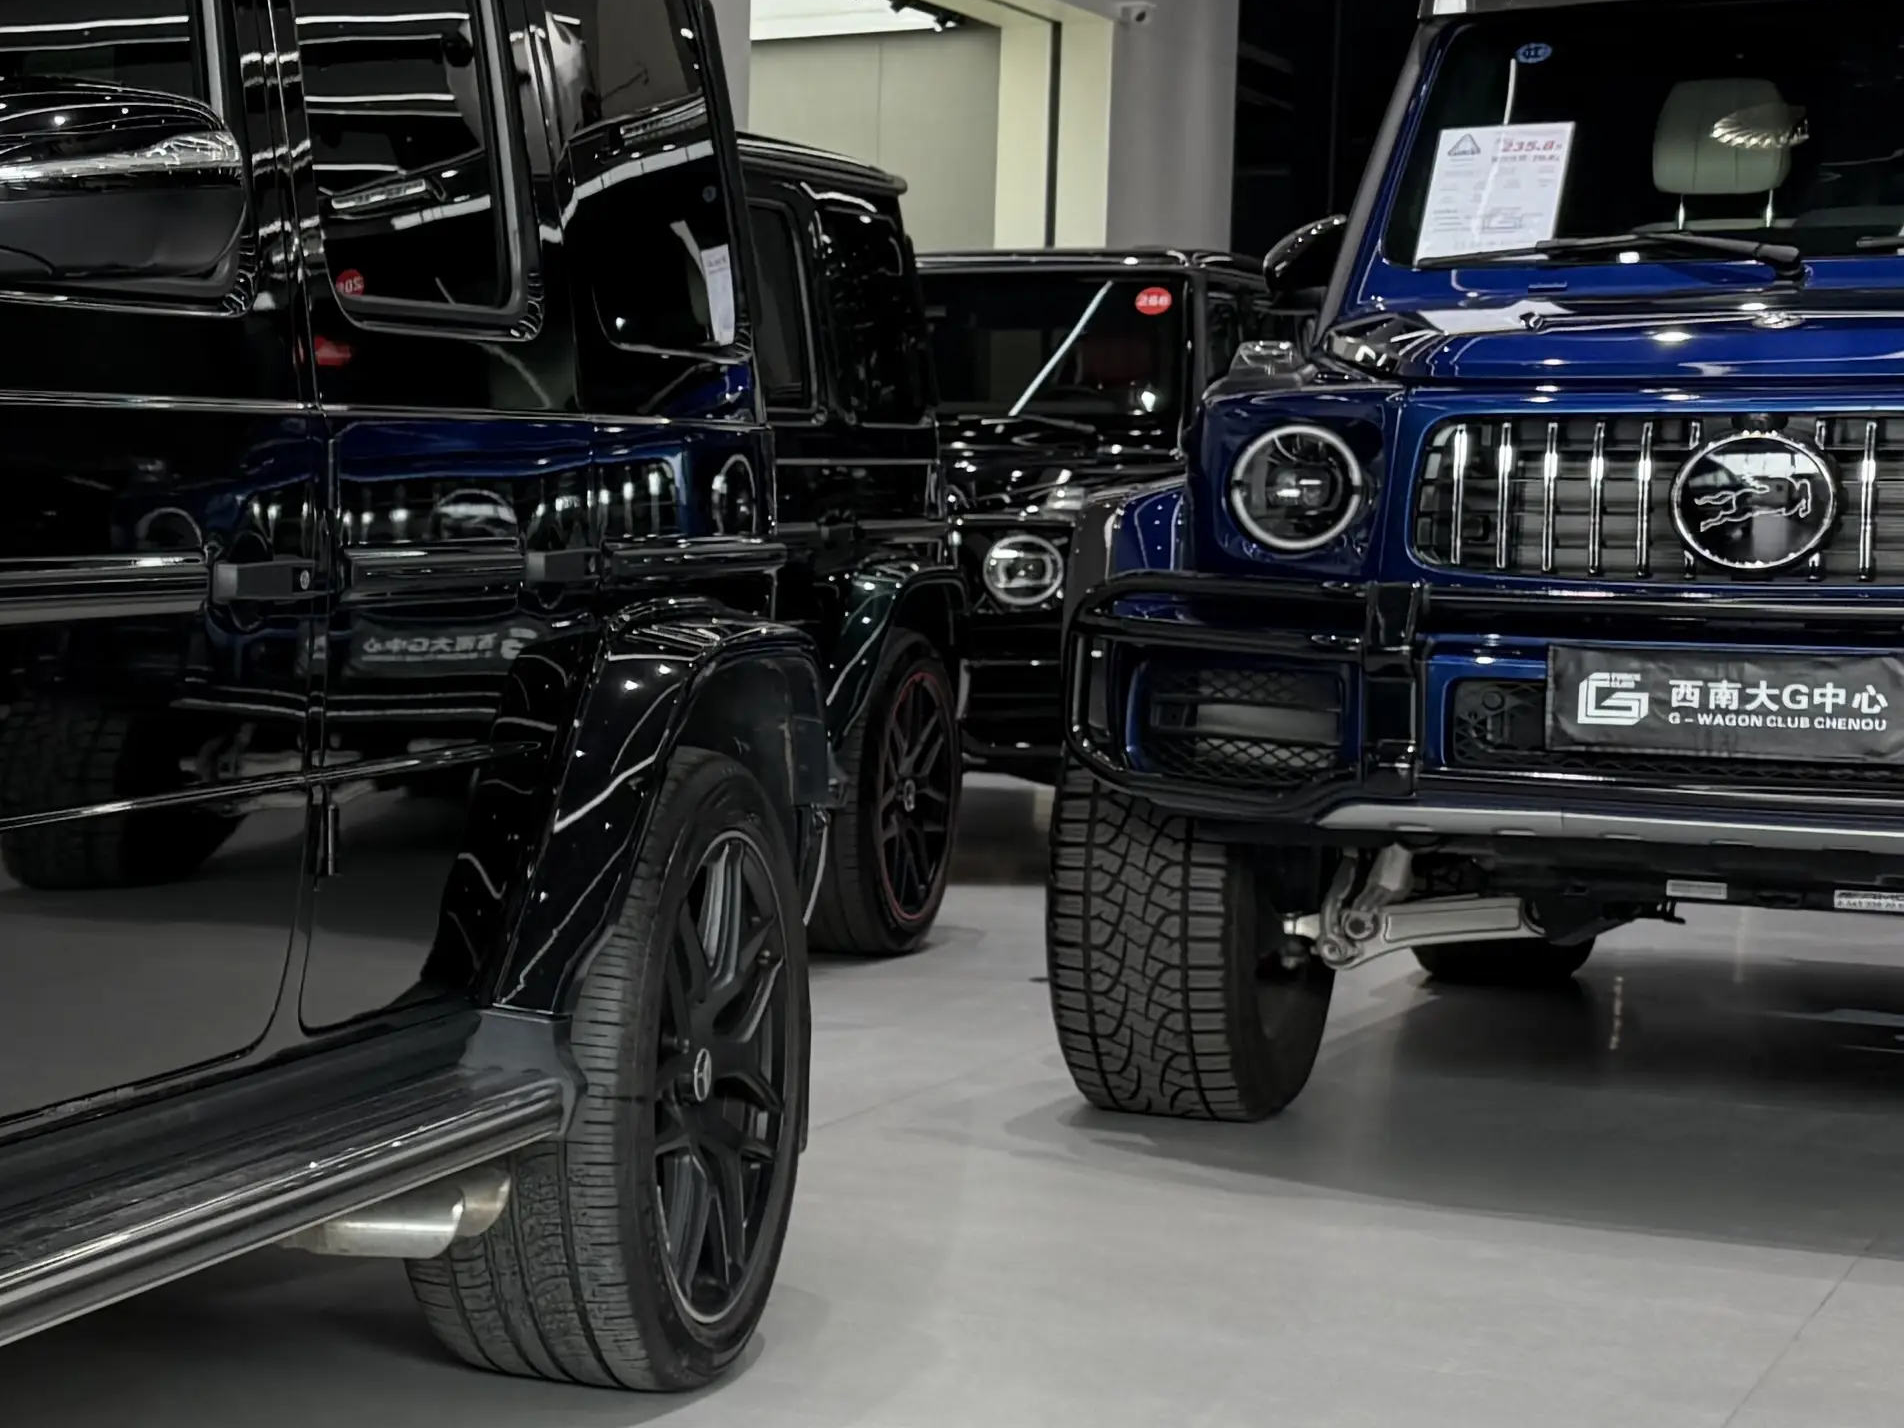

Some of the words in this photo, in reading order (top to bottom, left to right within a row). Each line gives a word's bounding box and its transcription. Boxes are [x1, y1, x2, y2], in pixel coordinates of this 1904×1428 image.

[1668, 679, 1889, 714] 西南大G中心
[1766, 715, 1810, 729] CLUB
